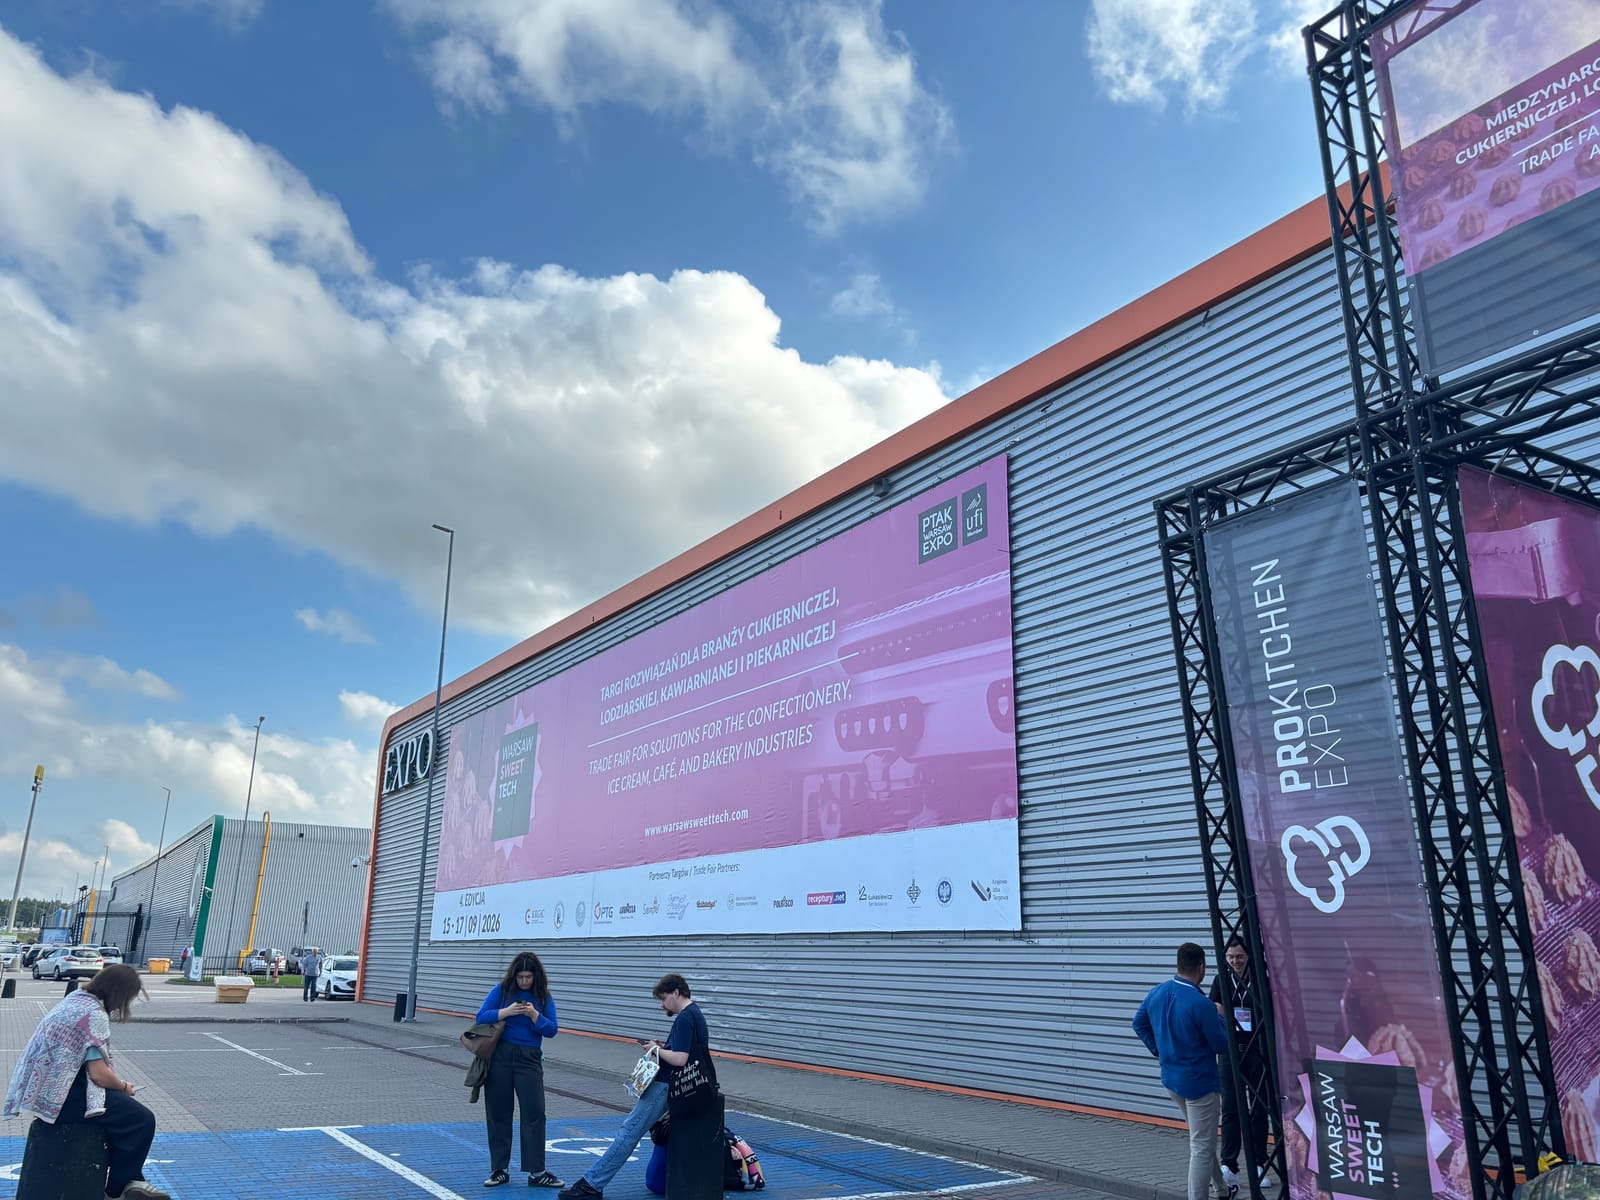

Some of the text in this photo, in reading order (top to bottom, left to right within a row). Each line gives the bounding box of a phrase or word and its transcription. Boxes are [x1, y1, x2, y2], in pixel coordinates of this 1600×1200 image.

[1455, 91, 1581, 164] CUKIERNICZEJ,
[1518, 135, 1574, 174] TRADE
[922, 506, 952, 533] PTAK
[923, 521, 952, 541] WARSAW
[923, 532, 953, 556] EXPO
[966, 508, 983, 530] ufi
[600, 587, 840, 702] TARGI ROZWIĄZAŃ DLA BRANŻY CUKIERNICZEJ,
[600, 620, 836, 726] LODZIARSKIEJ, KAWIARNIANEJ I PIEKARNICZEJ
[1251, 558, 1312, 794] PROKITCHEN
[502, 736, 534, 761] WARSAW
[589, 680, 851, 777] TRADE FAIR FOR SOLUTIONS FOR THE CONFECTIONERY,
[1303, 683, 1349, 789] EXPO
[382, 729, 433, 793] EXPO
[500, 758, 525, 780] SWEET
[607, 724, 813, 795] ICE CREAM, CAFÉ, AND BAKERY INDUSTRIES
[499, 780, 517, 800] TECH
[644, 808, 749, 837] www.warsawsweettech.com
[649, 871, 671, 881] Partnerzy
[693, 864, 707, 875] Trade
[707, 864, 717, 874] Fair
[465, 891, 486, 907] EDYCJA
[1318, 1072, 1345, 1179] WARSAW
[1341, 1098, 1365, 1183] SWEET
[1364, 1120, 1385, 1186] TECH
